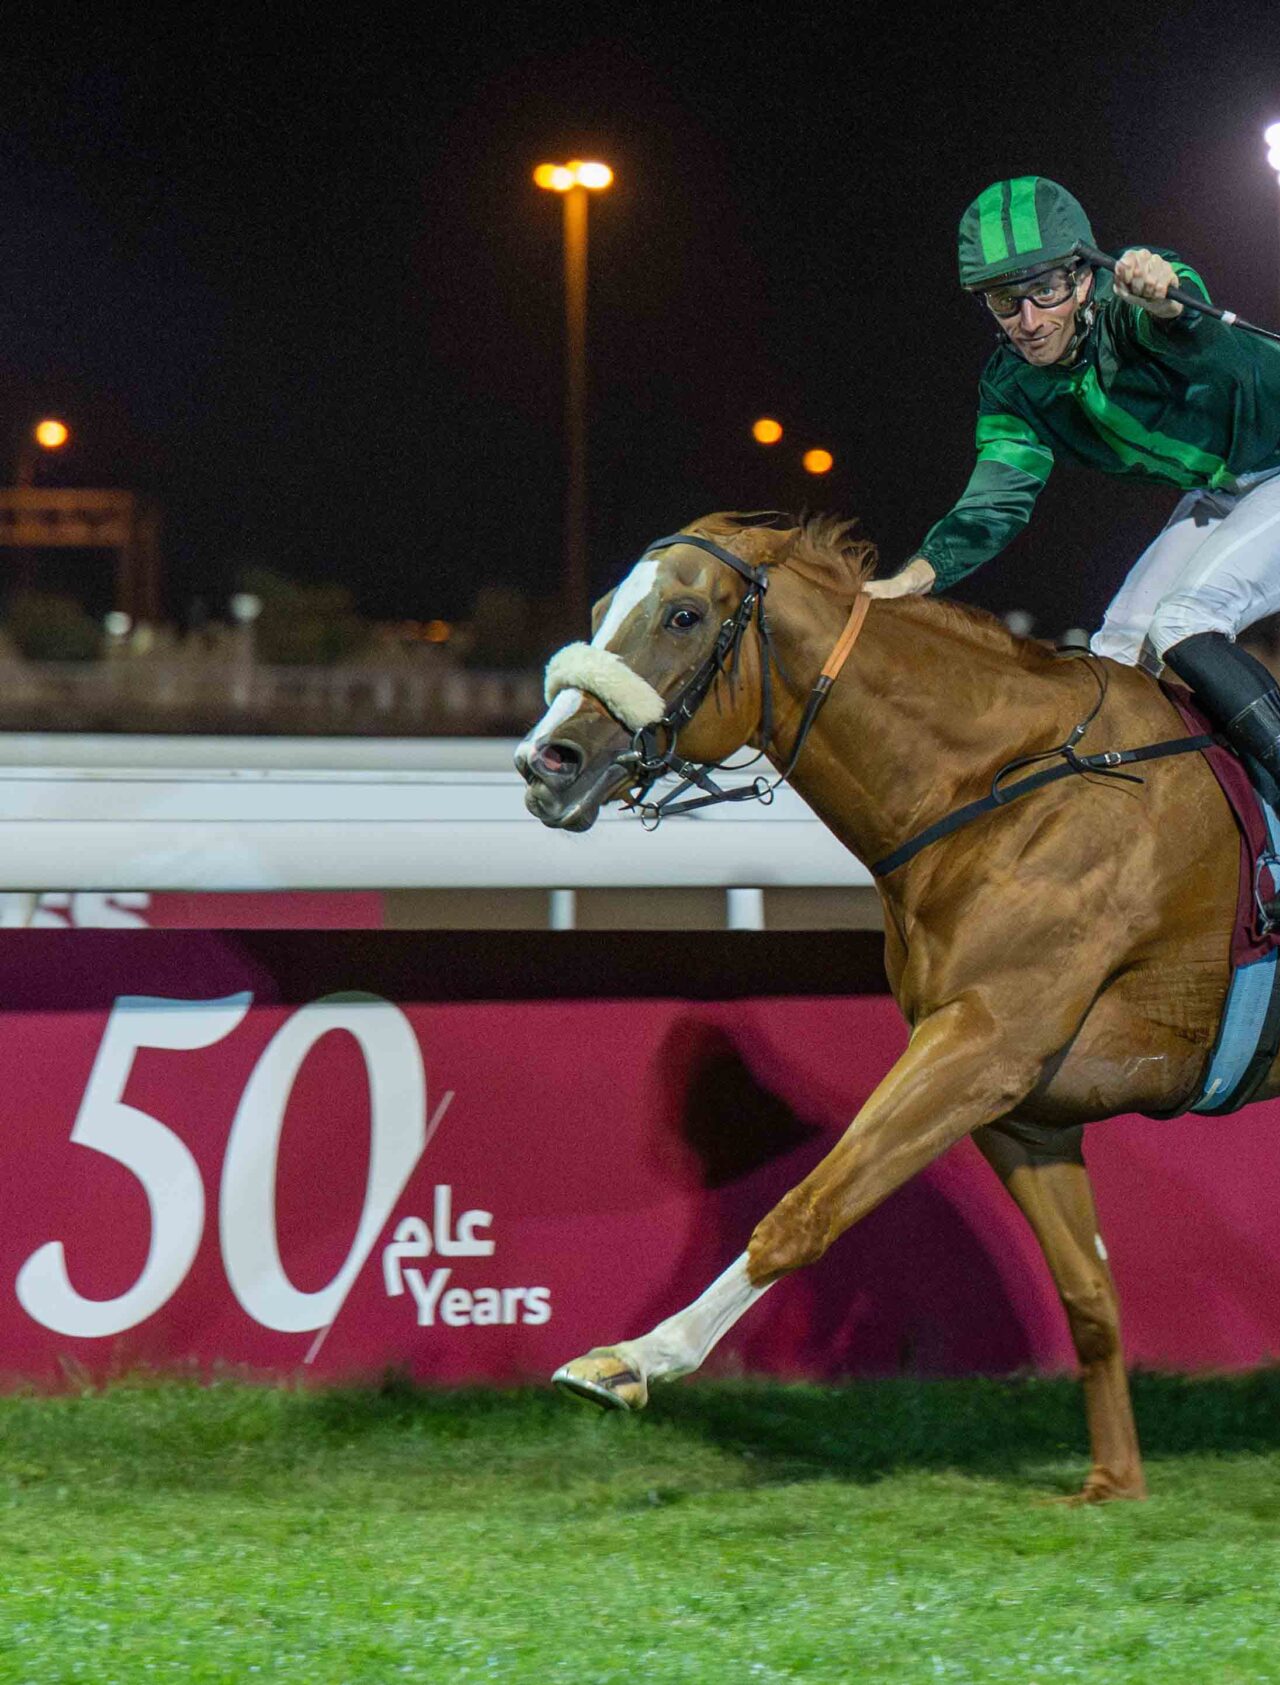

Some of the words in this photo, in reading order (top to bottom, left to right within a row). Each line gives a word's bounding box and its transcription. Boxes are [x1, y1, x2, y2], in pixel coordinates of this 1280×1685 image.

[16, 991, 427, 1338] 50
[382, 1184, 495, 1297] عام
[403, 1268, 552, 1327] Years
